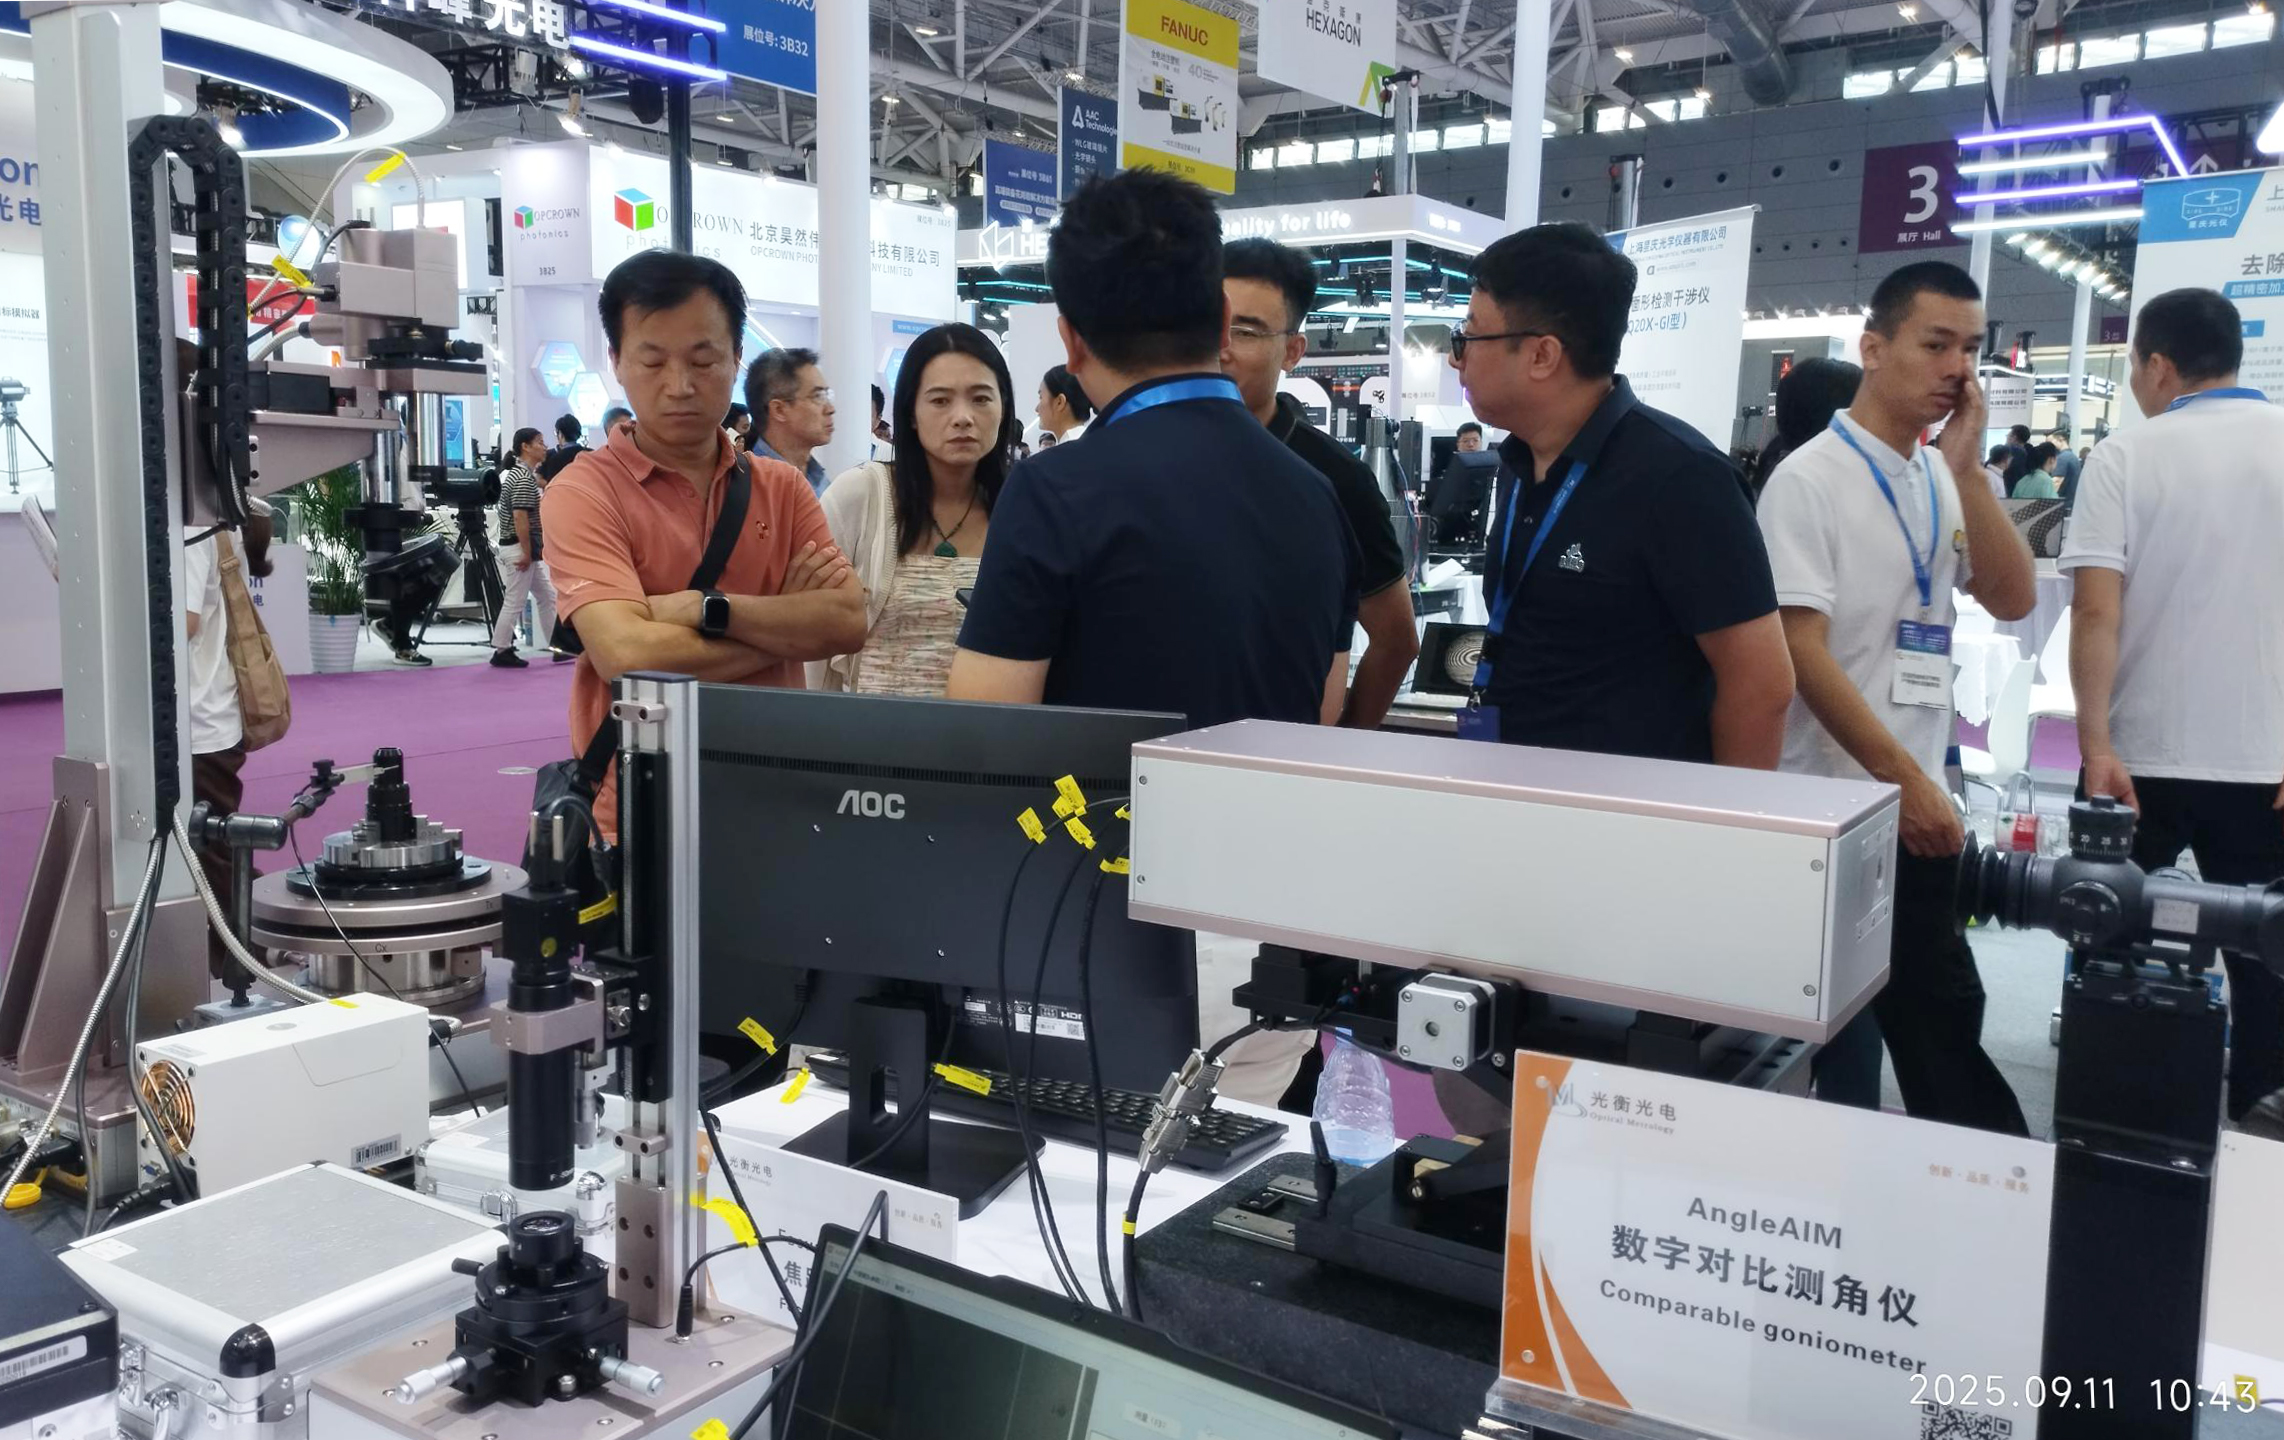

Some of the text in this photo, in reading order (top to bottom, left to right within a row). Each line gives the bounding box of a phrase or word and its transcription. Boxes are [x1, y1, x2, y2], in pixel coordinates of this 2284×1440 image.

[1161, 15, 1208, 46] FANUC
[1306, 7, 1361, 47] HEXAGON
[1085, 109, 1100, 121] AAC
[1085, 118, 1117, 137] Technologie
[1903, 165, 1939, 223] 3
[534, 208, 580, 221] OPCROWN
[657, 205, 743, 235] OROWN
[1222, 211, 1351, 236] uality for life
[1923, 230, 1941, 241] Hall
[750, 245, 795, 261] OPCROWN
[836, 789, 906, 820] AOC
[2080, 834, 2090, 844] 20
[1591, 1091, 1677, 1122] 光衡光电
[1590, 1111, 1675, 1135] Optical Metrology
[730, 1156, 772, 1178] 光衡光电
[1687, 1197, 1842, 1249] AngleAIM
[1612, 1223, 1919, 1328] 数字对比测角仪
[1600, 1279, 1927, 1374] Comparable goniometer
